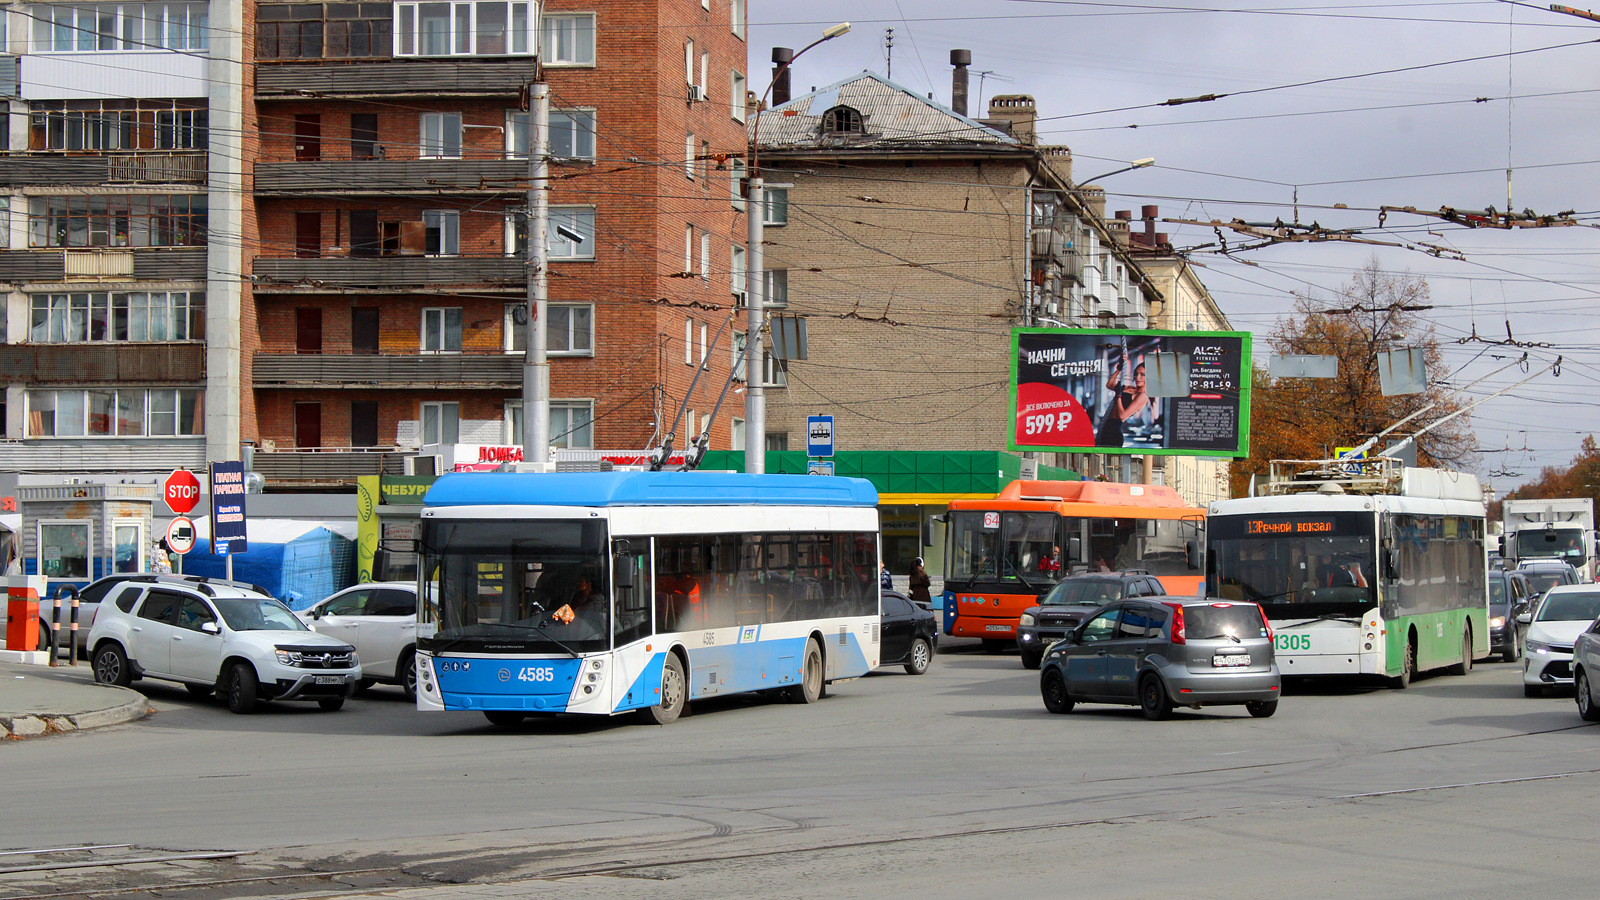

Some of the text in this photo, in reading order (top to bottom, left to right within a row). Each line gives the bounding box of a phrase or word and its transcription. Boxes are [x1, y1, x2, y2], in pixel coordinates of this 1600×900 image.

[1027, 347, 1066, 364] НАЧНИ
[1193, 346, 1221, 355] ALEX
[1050, 359, 1105, 377] СЕГОДНЯ!
[1026, 400, 1071, 412] ВСЕ ВКЛЮЧЕНО ЗА
[1025, 411, 1072, 435] 599 ₽
[215, 472, 242, 483] ПЛАТНАЯ
[169, 485, 198, 498] STOP
[214, 484, 244, 494] ПАРКОВКА
[984, 513, 1000, 527] 64
[1297, 522, 1332, 532] вокзал
[703, 632, 715, 645] 4585
[1273, 634, 1311, 650] 1305
[518, 667, 554, 682] 4585
